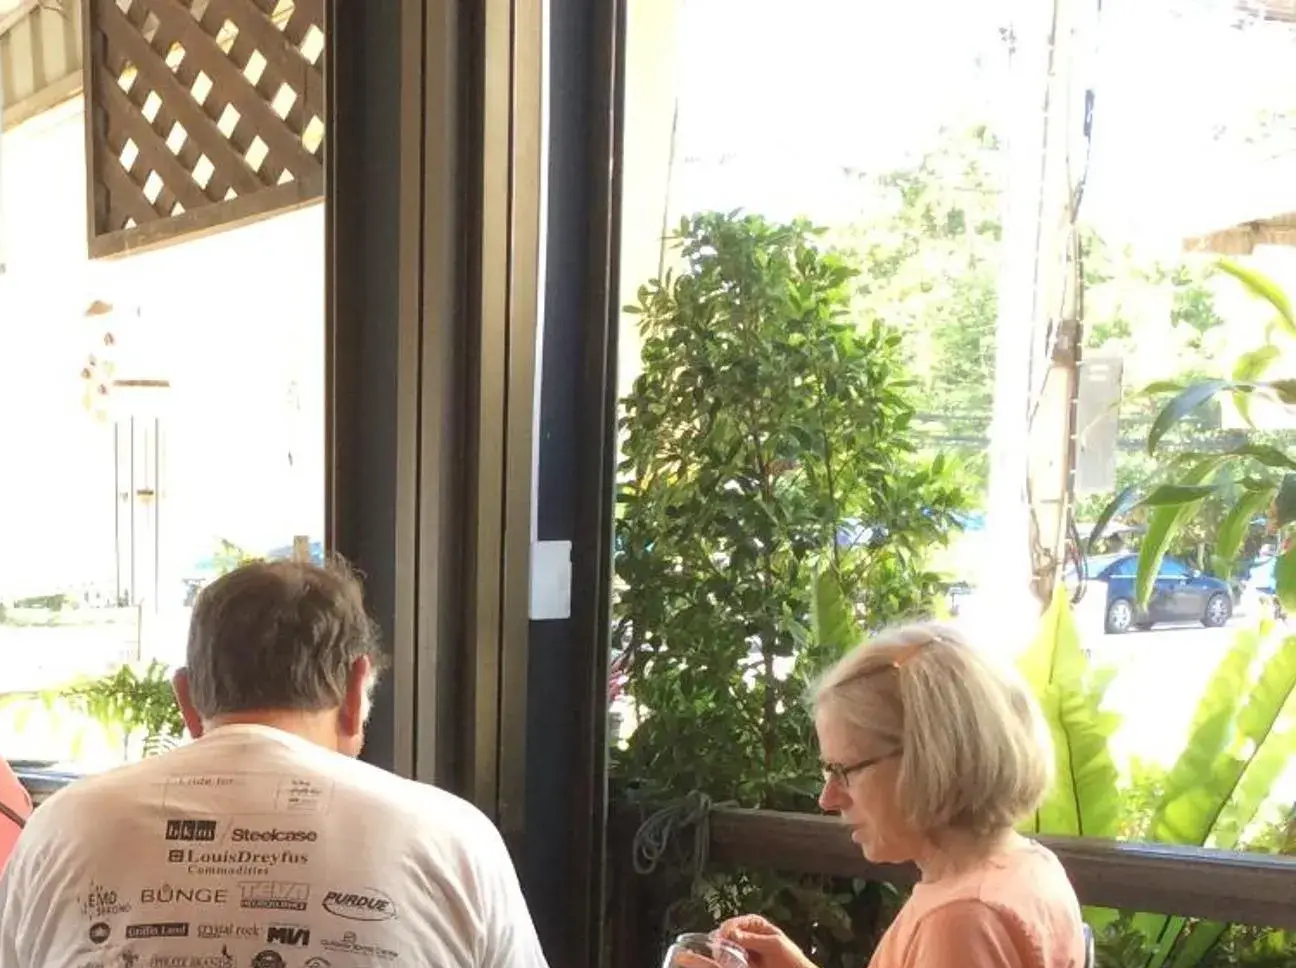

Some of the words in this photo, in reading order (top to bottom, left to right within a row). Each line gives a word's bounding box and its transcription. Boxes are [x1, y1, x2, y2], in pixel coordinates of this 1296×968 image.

[232, 828, 317, 842] Steelcase
[188, 865, 269, 876] Commodities
[326, 891, 390, 912] PURDUE
